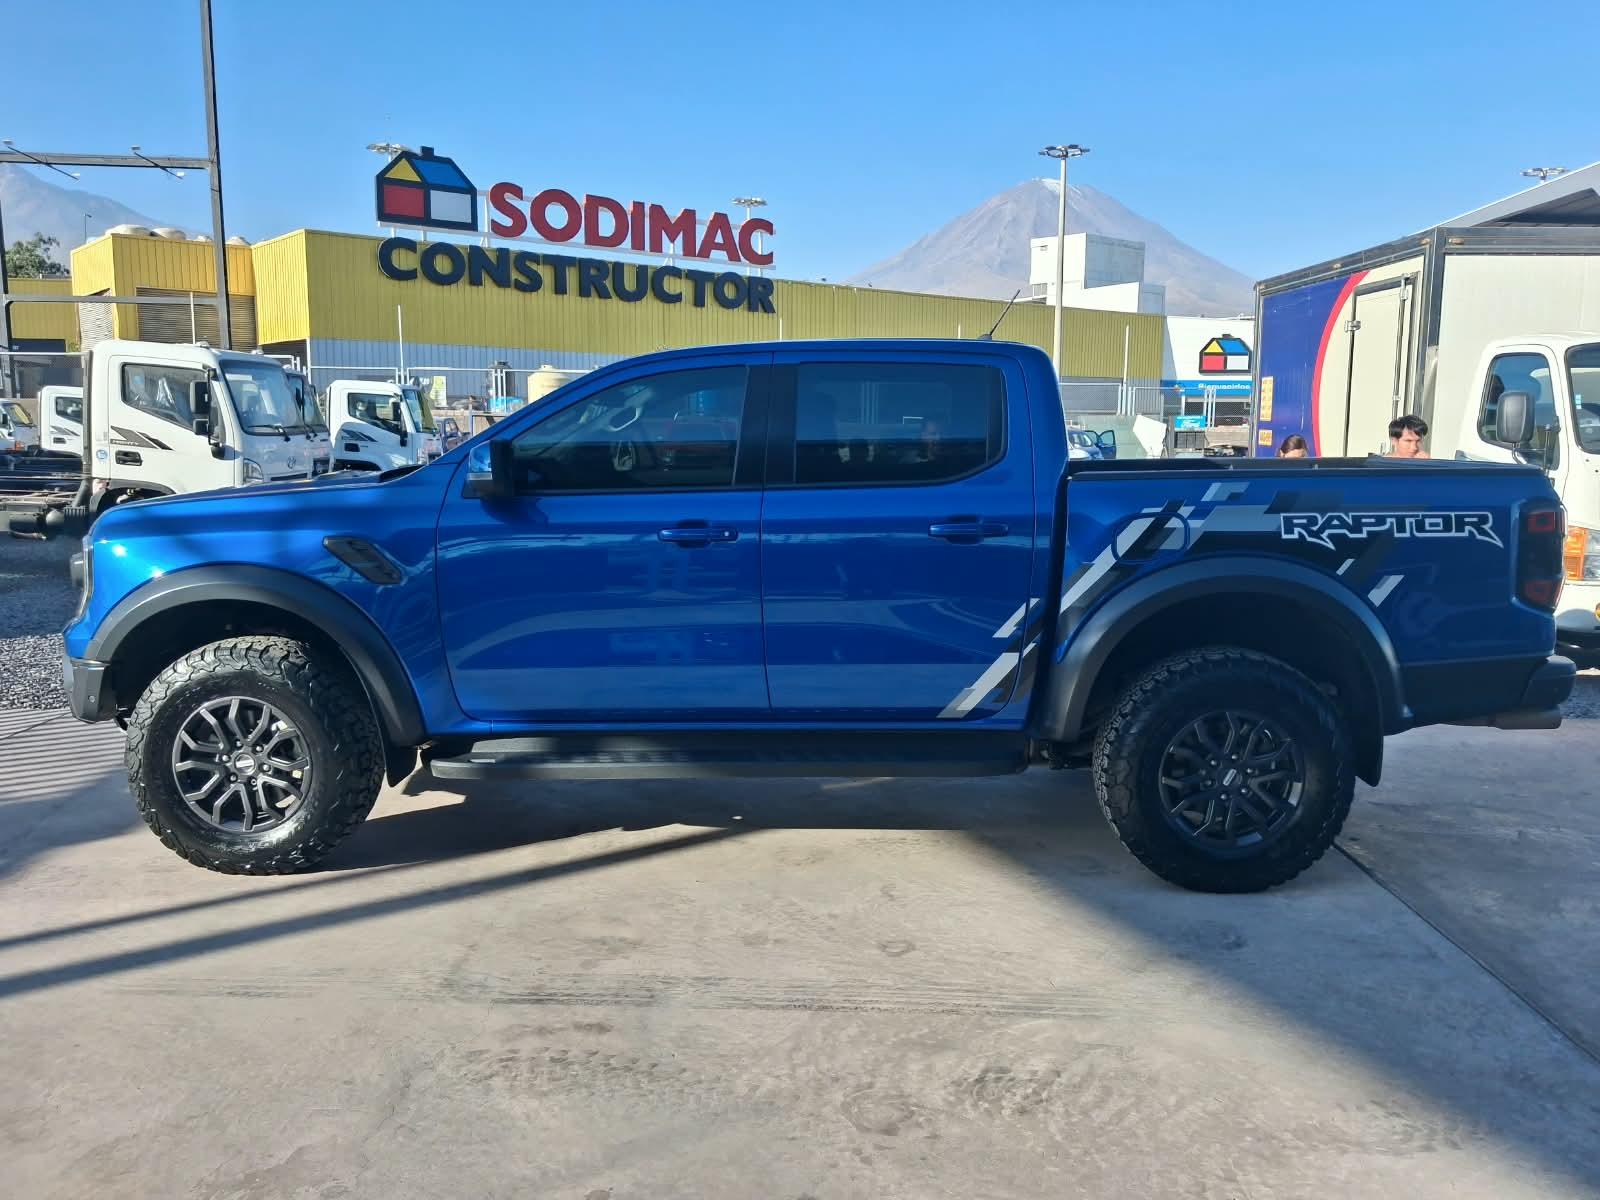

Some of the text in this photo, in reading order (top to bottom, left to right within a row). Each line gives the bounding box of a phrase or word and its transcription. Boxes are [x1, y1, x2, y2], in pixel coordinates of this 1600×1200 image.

[489, 182, 774, 265] SODIMAC
[377, 237, 776, 313] CONSTRUCTOR
[1280, 511, 1504, 550] RAPTOR
